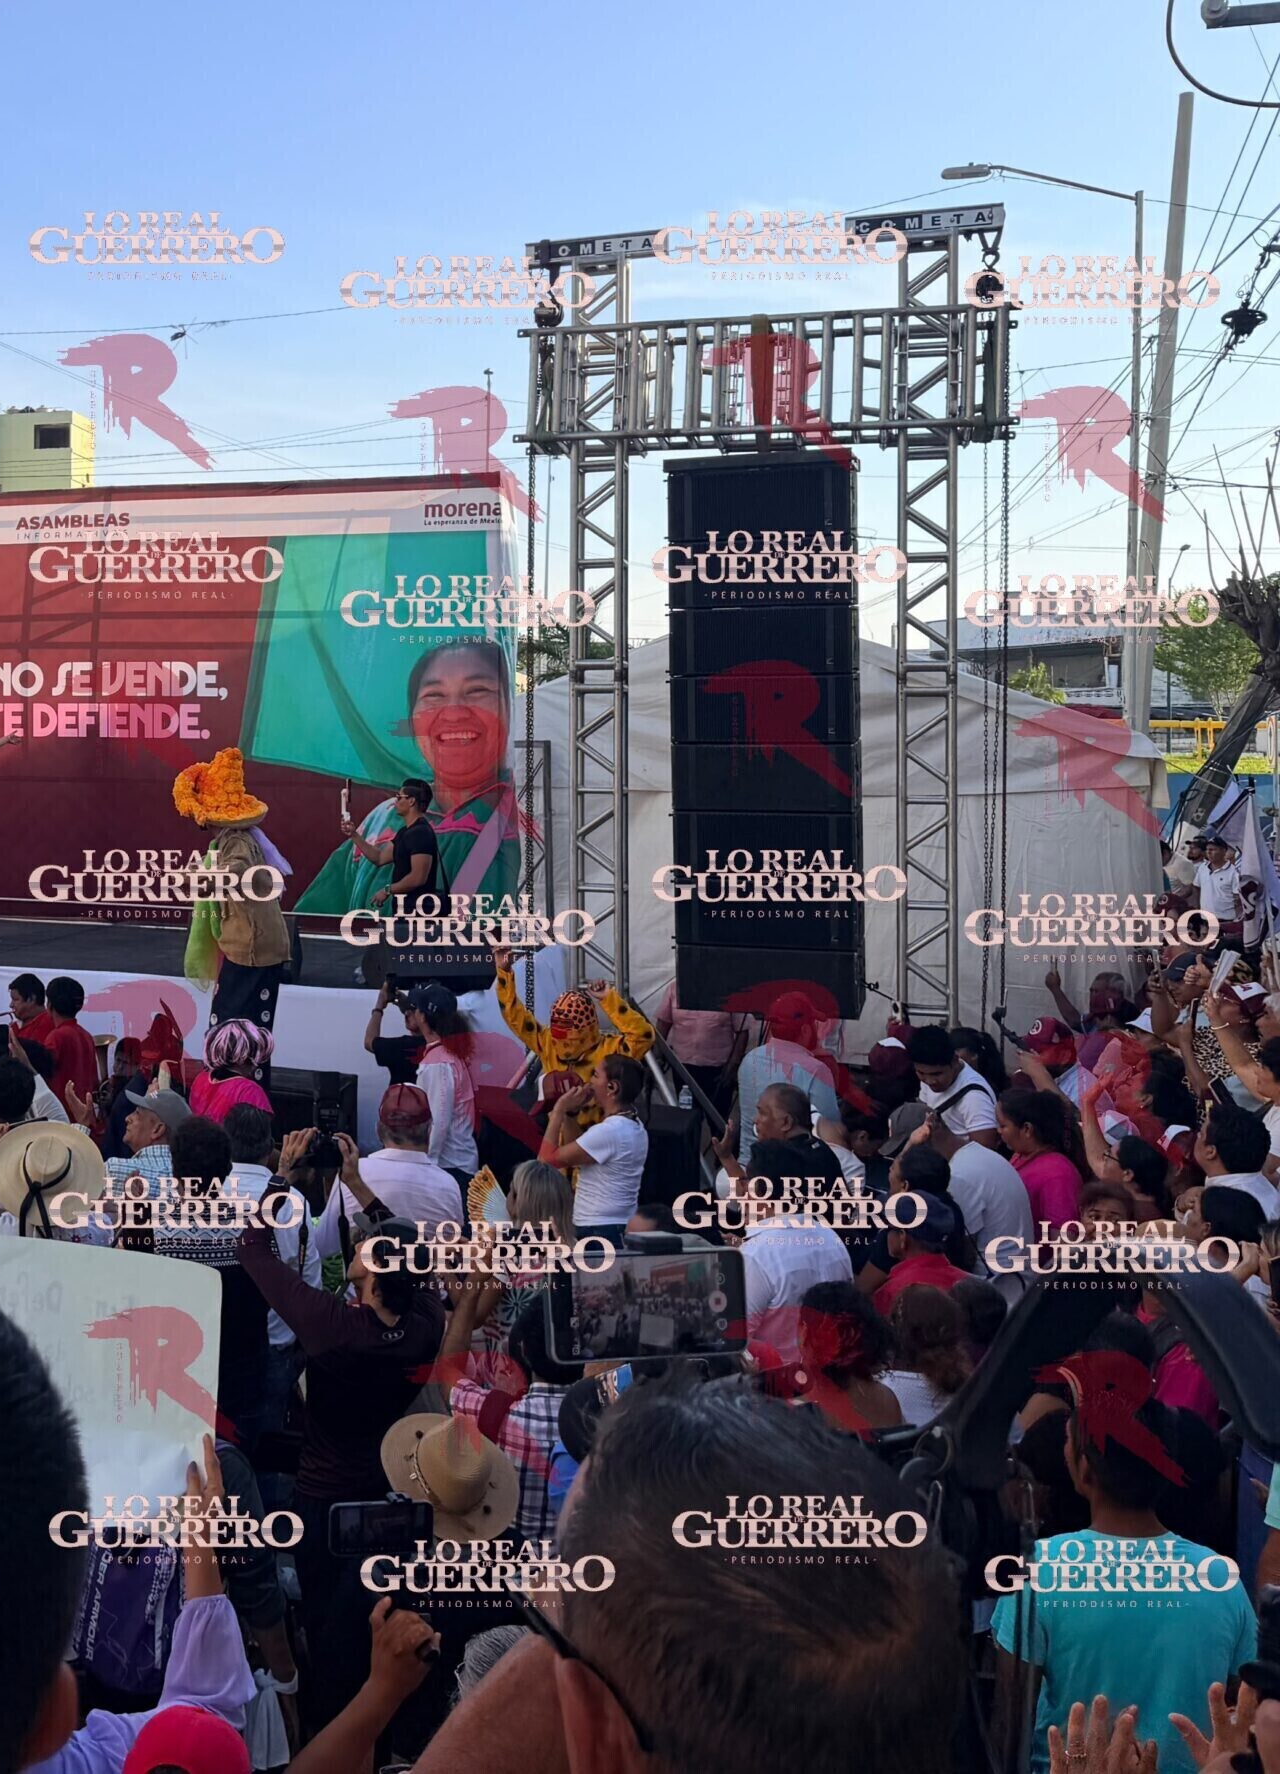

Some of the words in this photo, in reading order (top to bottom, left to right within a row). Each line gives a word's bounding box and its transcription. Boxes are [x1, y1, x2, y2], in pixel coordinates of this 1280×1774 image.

[858, 210, 990, 234] COMETA
[537, 236, 654, 258] OMETA
[15, 512, 130, 530] ASAMBLEAS
[424, 501, 502, 518] morena
[52, 661, 93, 697] SE
[101, 661, 229, 701] VENDE,
[32, 702, 211, 740] DEFIENDE.
